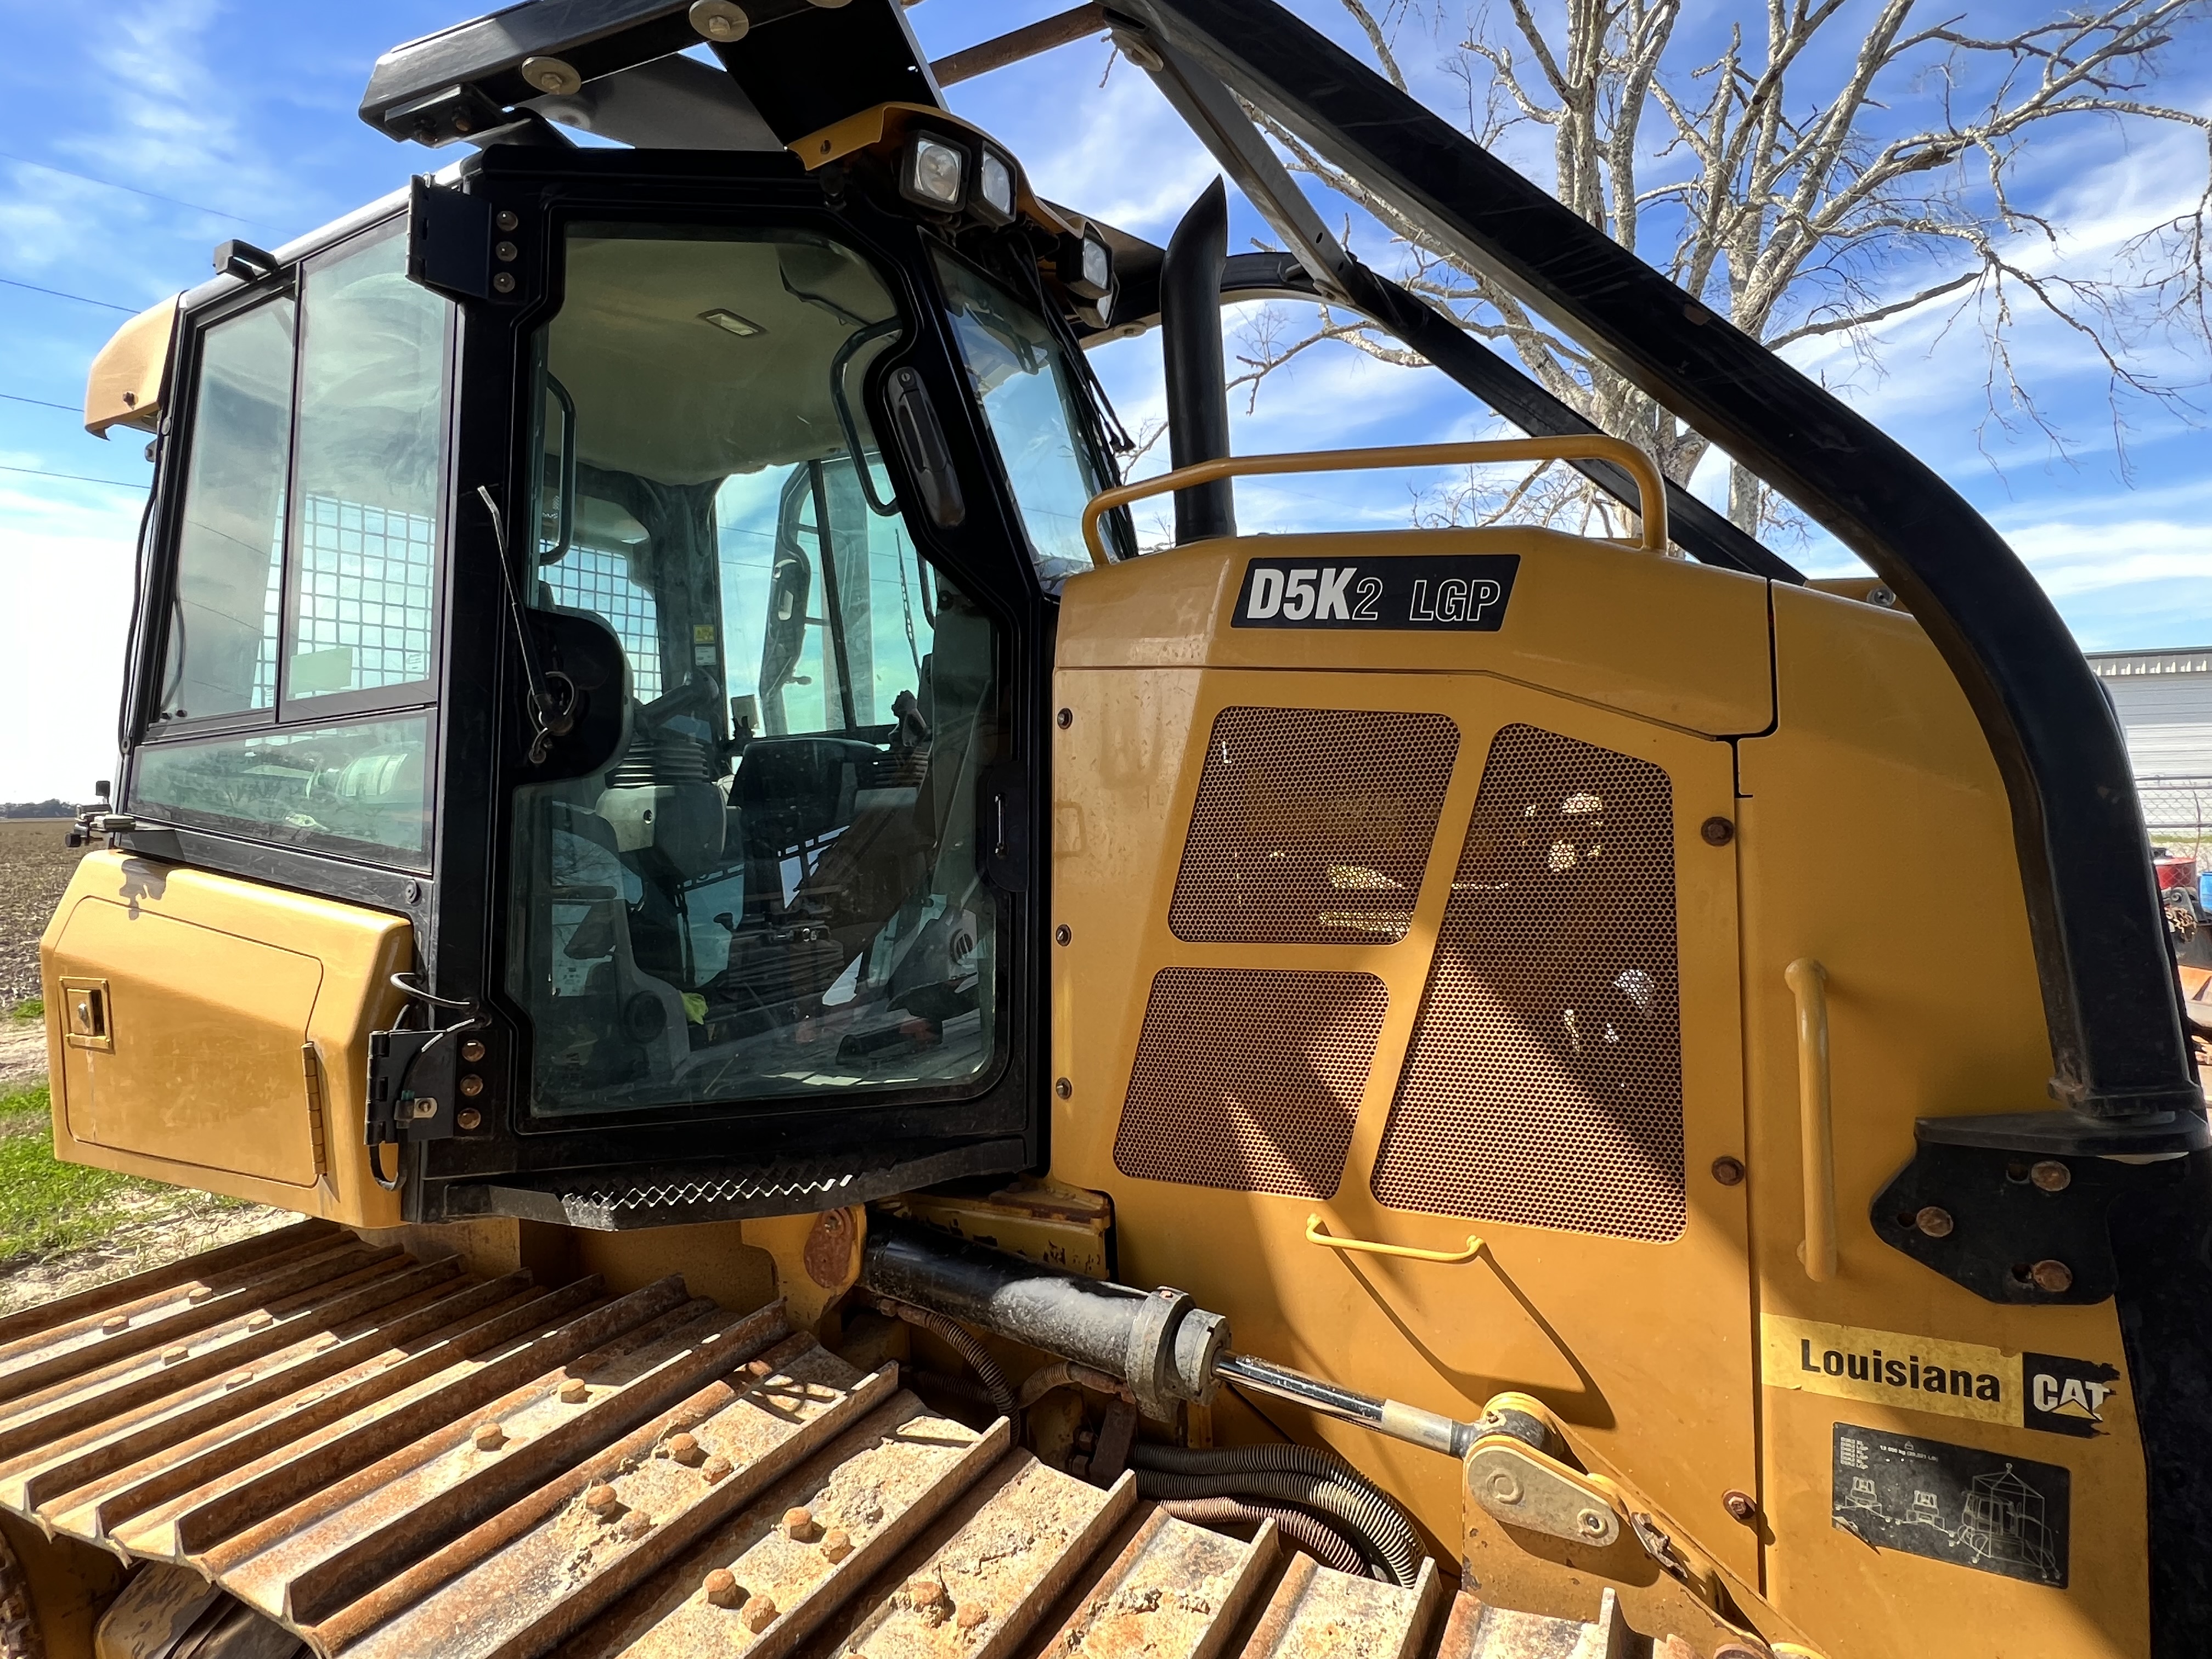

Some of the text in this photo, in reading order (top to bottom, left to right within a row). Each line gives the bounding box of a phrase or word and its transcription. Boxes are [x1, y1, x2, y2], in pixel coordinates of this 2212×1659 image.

[1246, 567, 1501, 622] D5K2 LGP
[1801, 1338, 2111, 1422] Louisiana CAT
